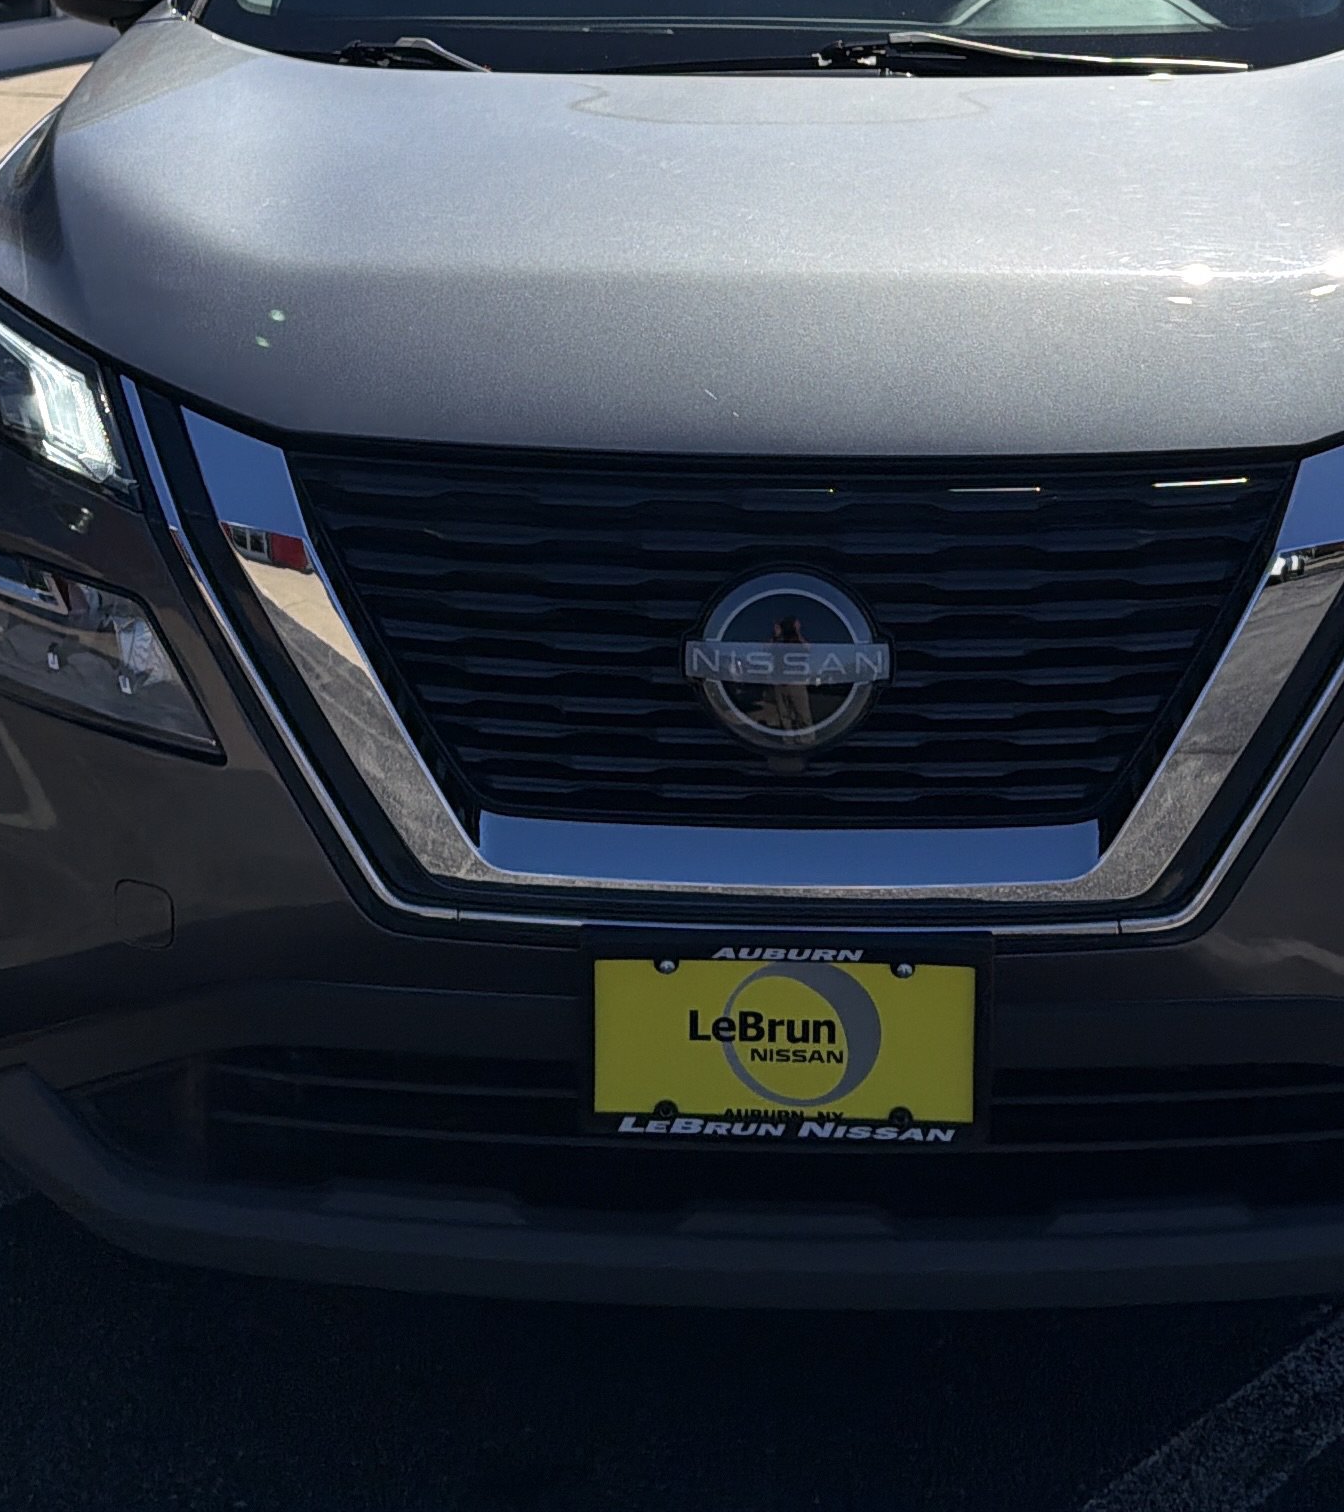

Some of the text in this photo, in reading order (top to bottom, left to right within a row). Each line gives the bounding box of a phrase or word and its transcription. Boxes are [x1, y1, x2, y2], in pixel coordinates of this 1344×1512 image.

[691, 646, 883, 675] NISSAN
[711, 946, 863, 963] AUBURN
[689, 1009, 837, 1045] LeBrun
[750, 1048, 845, 1065] NISSAN
[797, 1121, 956, 1144] NISSAN
